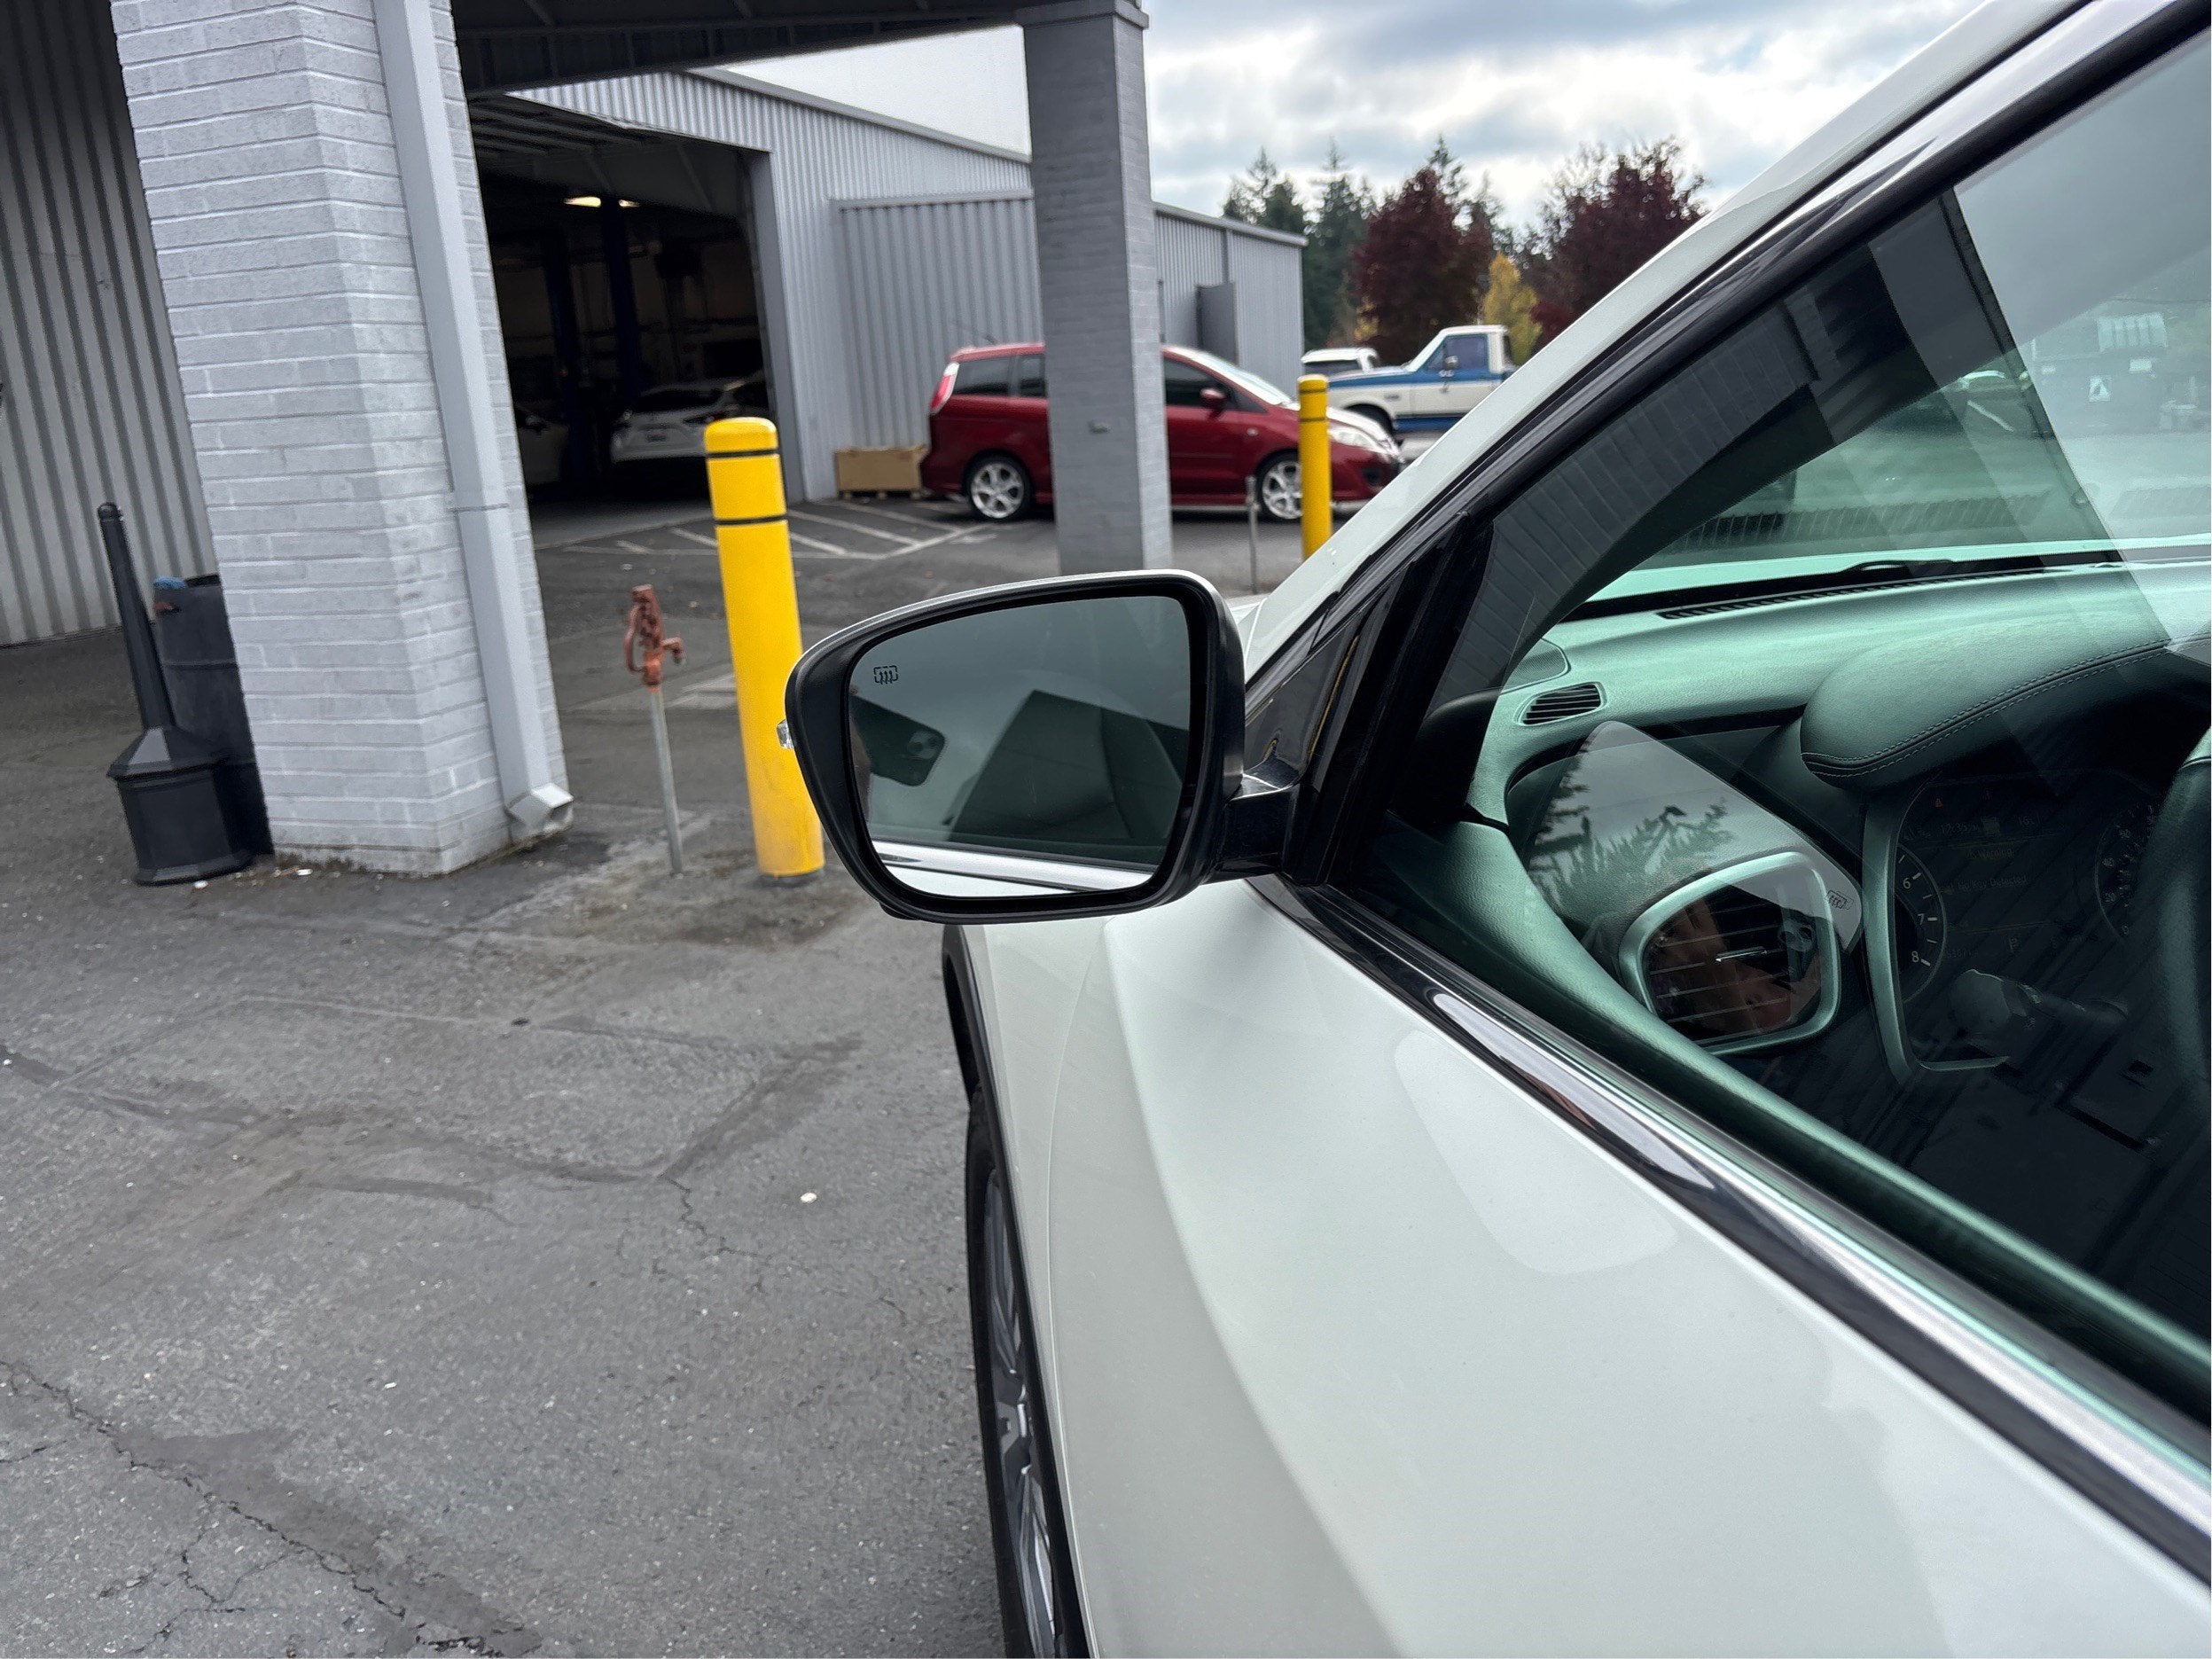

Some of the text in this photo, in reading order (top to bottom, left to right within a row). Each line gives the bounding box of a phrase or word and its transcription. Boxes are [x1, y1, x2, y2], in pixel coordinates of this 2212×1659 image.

[1903, 878, 1911, 889] 6
[1917, 913, 1925, 926] 7
[1911, 951, 1919, 963] 8
